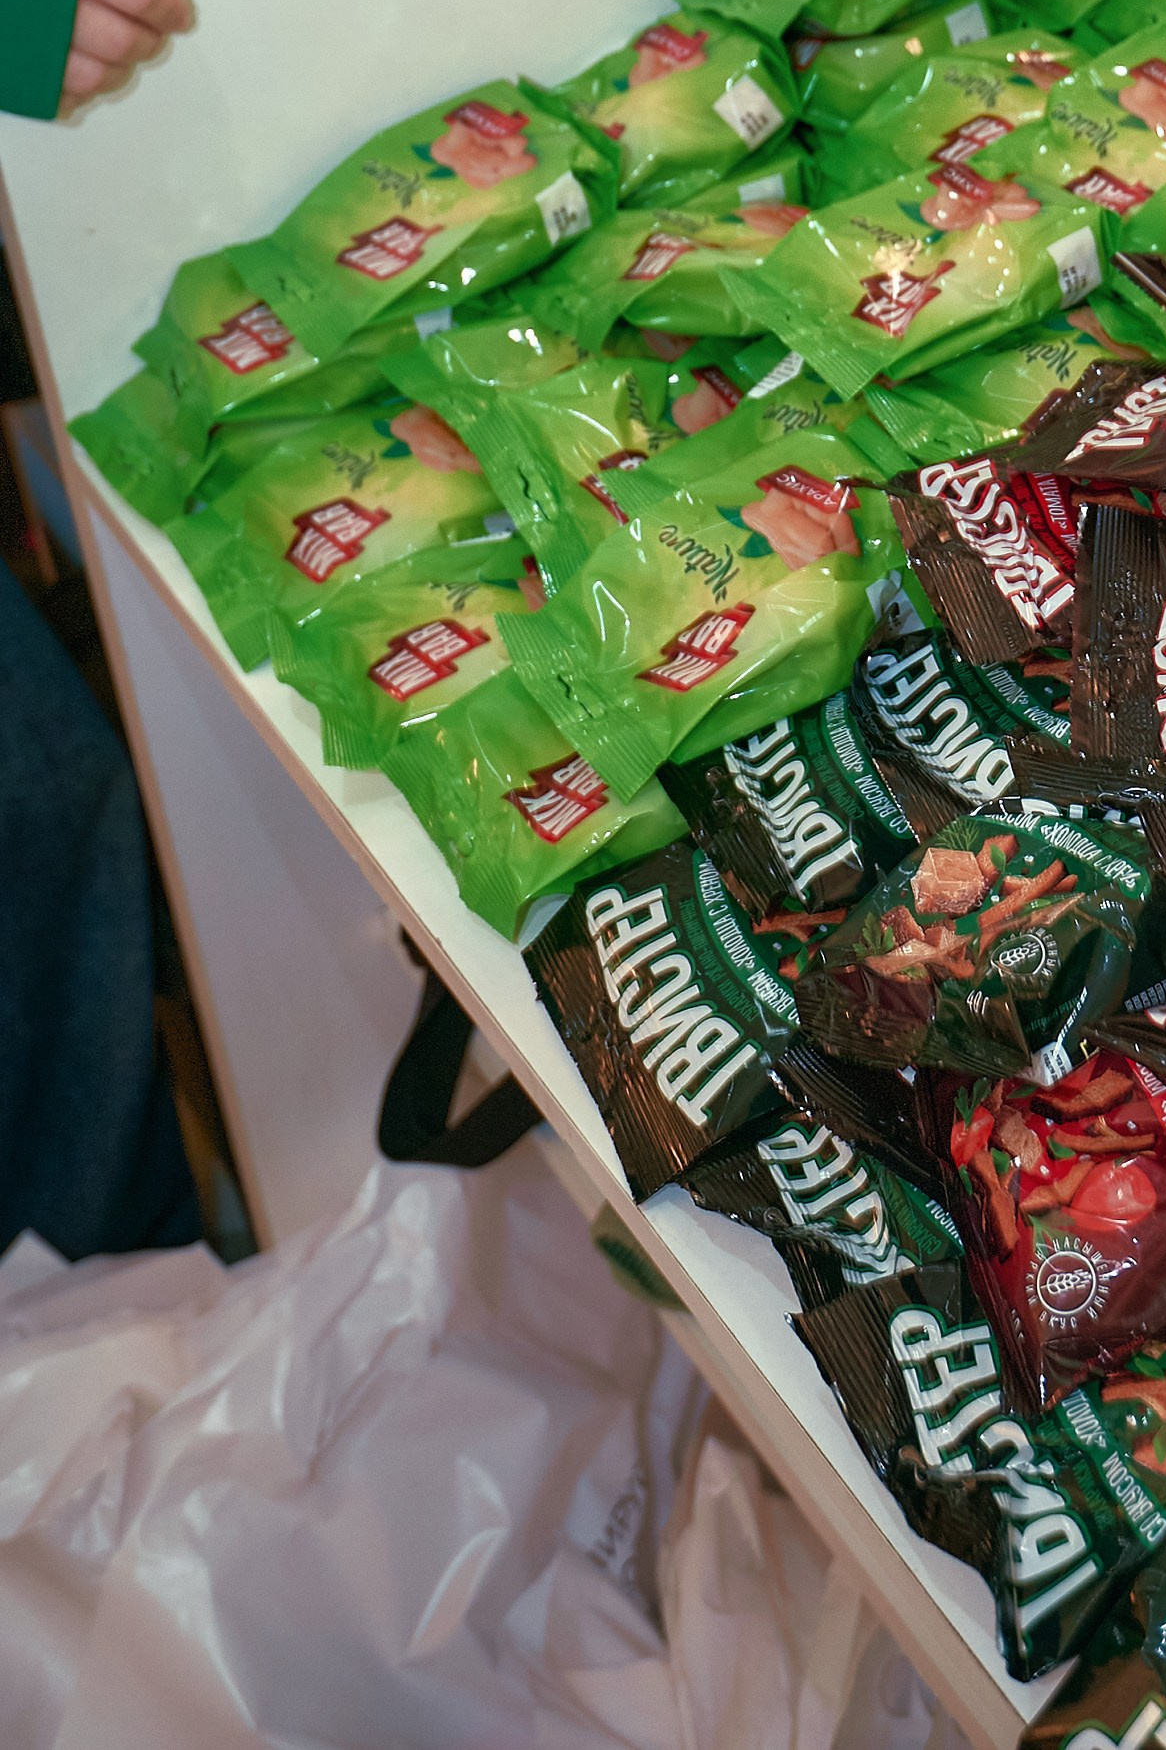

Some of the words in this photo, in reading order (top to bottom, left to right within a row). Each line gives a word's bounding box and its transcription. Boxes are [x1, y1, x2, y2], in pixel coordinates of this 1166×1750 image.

[658, 525, 740, 604] Nature
[405, 620, 470, 662] BAR
[650, 652, 719, 686] MIX
[863, 643, 1016, 802] ВИСТЕР
[1024, 703, 1072, 740] ВКУСОМ
[518, 789, 588, 835] MIX
[721, 716, 861, 901] ТВИСТЕ
[855, 773, 898, 820] ВКУСОМ
[890, 814, 909, 835] СО
[1040, 821, 1103, 862] «ХОЛОДЦА
[716, 912, 756, 971] «ХОЛОДЦА
[585, 886, 756, 1126] ТВИСТЕР
[747, 967, 792, 1013] ВКУСОМ
[755, 1122, 921, 1287] СТЕР
[1101, 1450, 1154, 1517] ВКУСОМ
